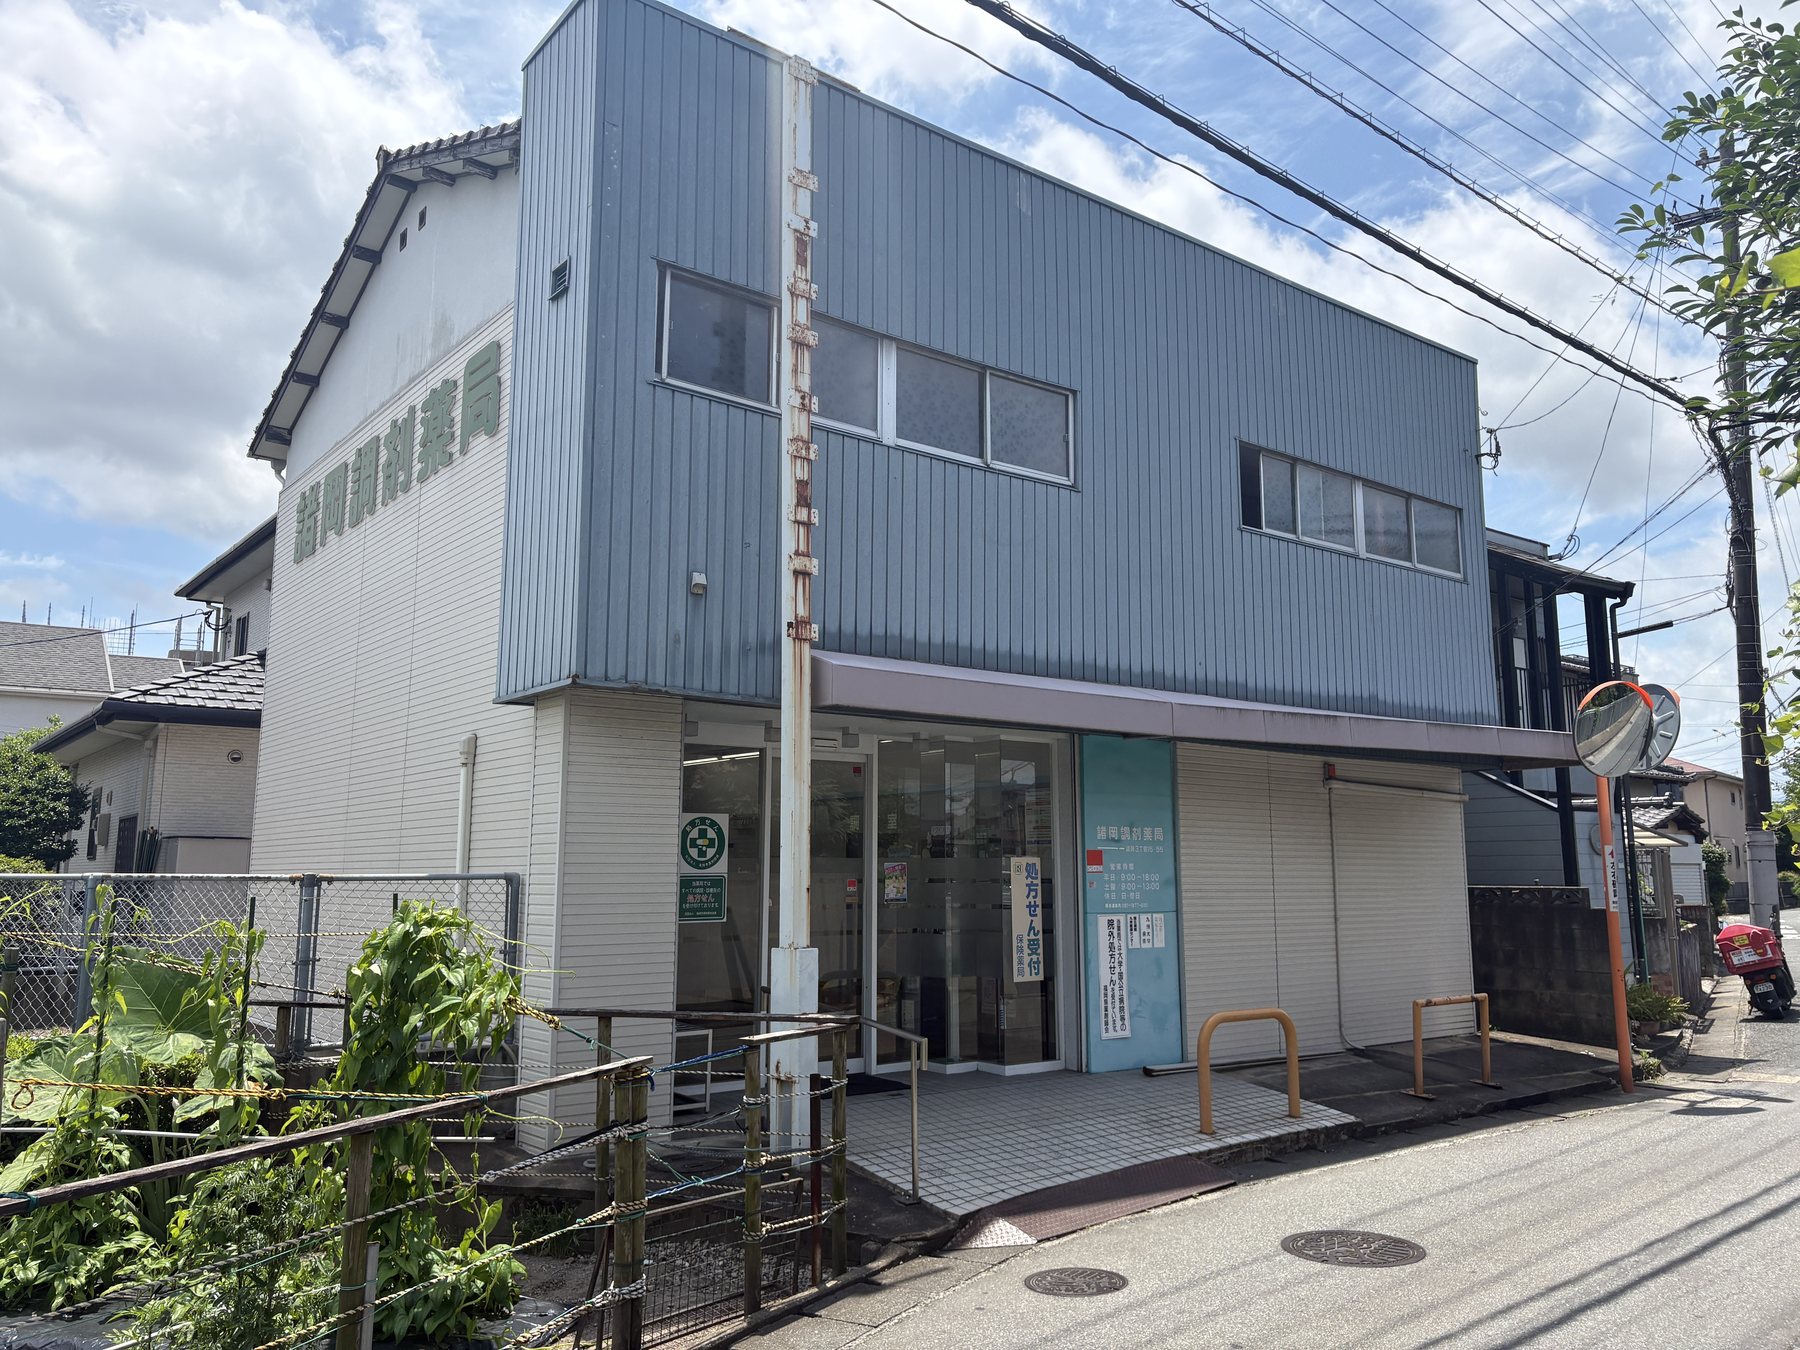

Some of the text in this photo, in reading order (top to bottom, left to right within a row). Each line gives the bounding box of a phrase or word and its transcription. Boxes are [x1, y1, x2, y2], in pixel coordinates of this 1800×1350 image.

[294, 340, 501, 564] 諸岡調剤薬局
[685, 818, 720, 833] 処方せん
[1096, 826, 1164, 841] 諸岡調剤薬局
[686, 893, 715, 903] 処方せん
[1024, 862, 1041, 977] 処方せん受付
[1015, 933, 1025, 978] 保険薬局
